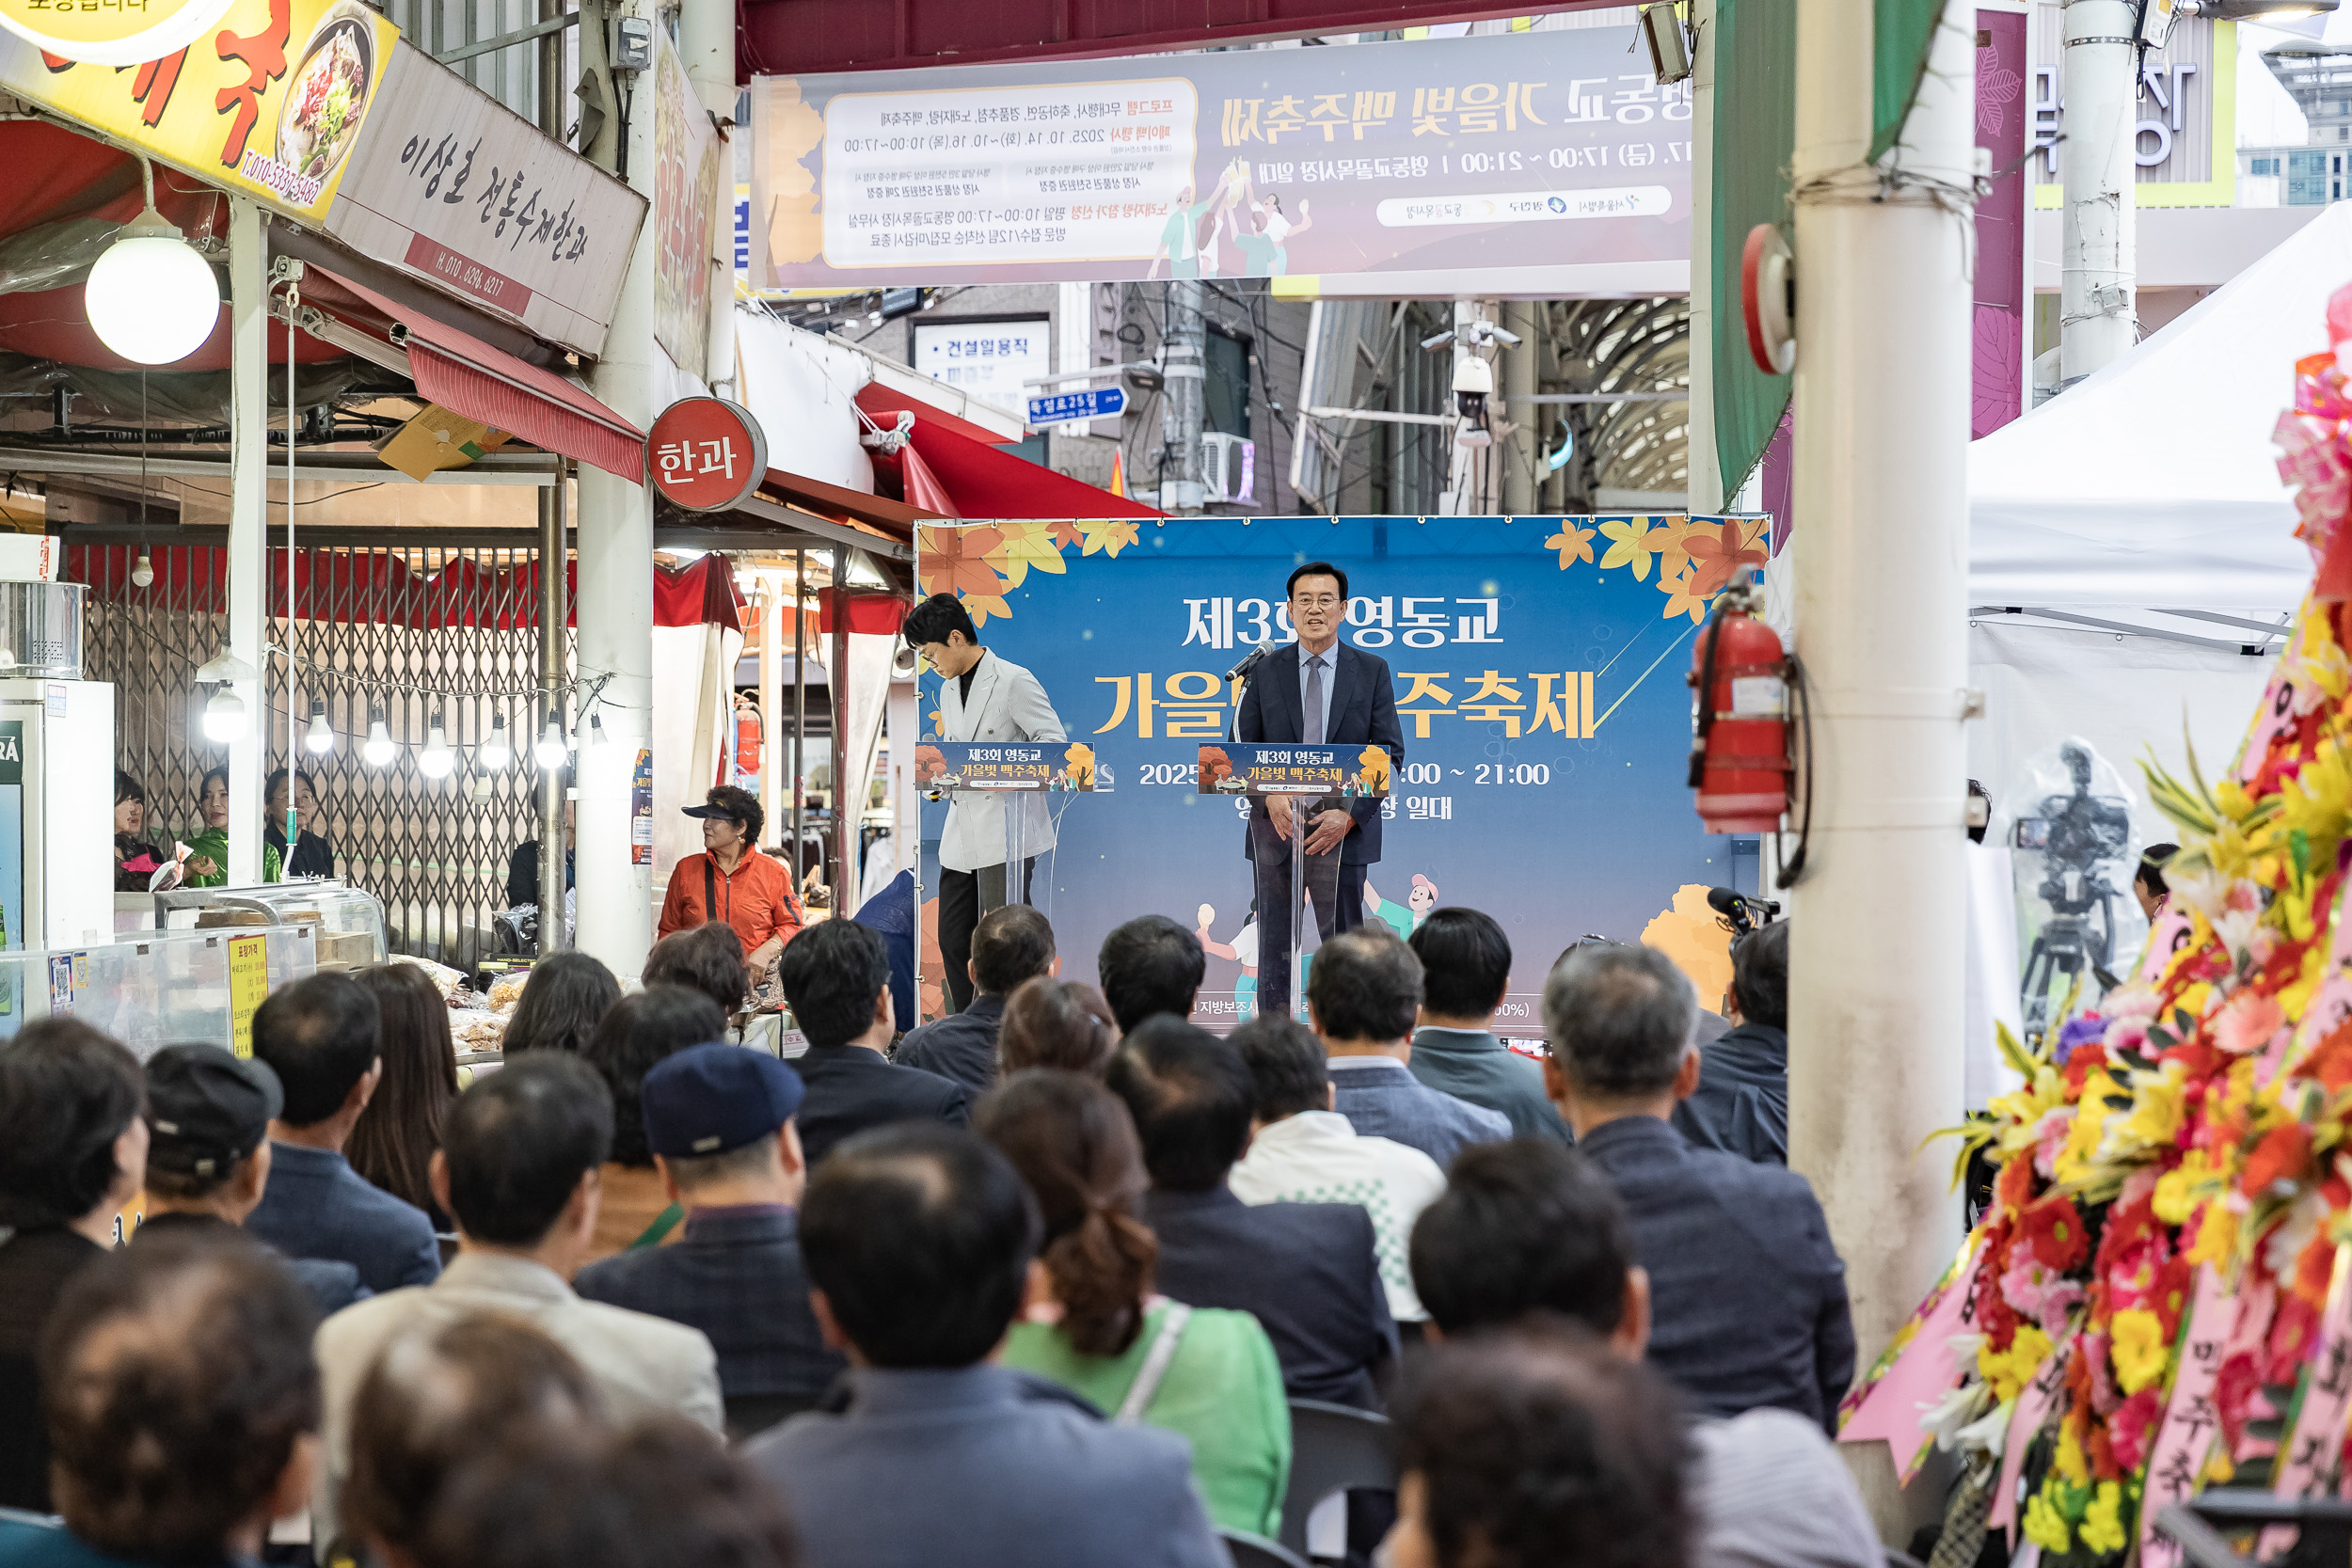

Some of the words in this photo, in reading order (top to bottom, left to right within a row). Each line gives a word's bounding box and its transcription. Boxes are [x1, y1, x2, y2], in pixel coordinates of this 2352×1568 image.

[241, 151, 319, 205] T.010-5337-5482
[401, 132, 482, 203] 이상호
[484, 276, 503, 297] 6217
[947, 337, 1028, 357] 건설일용직
[657, 436, 737, 485] 한과
[1346, 595, 1504, 649] 영동교
[1093, 671, 1244, 738] 가을
[1396, 669, 1594, 739] 주축제
[968, 748, 1001, 761] 제3회
[1005, 748, 1042, 761] 영동교
[1255, 750, 1290, 764] 제3회
[1295, 751, 1334, 765] 영동교
[961, 764, 997, 777] 가을빛
[1001, 764, 1050, 777] 맥주축제
[1247, 767, 1286, 781] 가을빛
[1290, 768, 1343, 782] 맥주축제
[1475, 763, 1549, 785] 21:00
[1406, 796, 1452, 820] 일대
[238, 943, 258, 958] 포장가격
